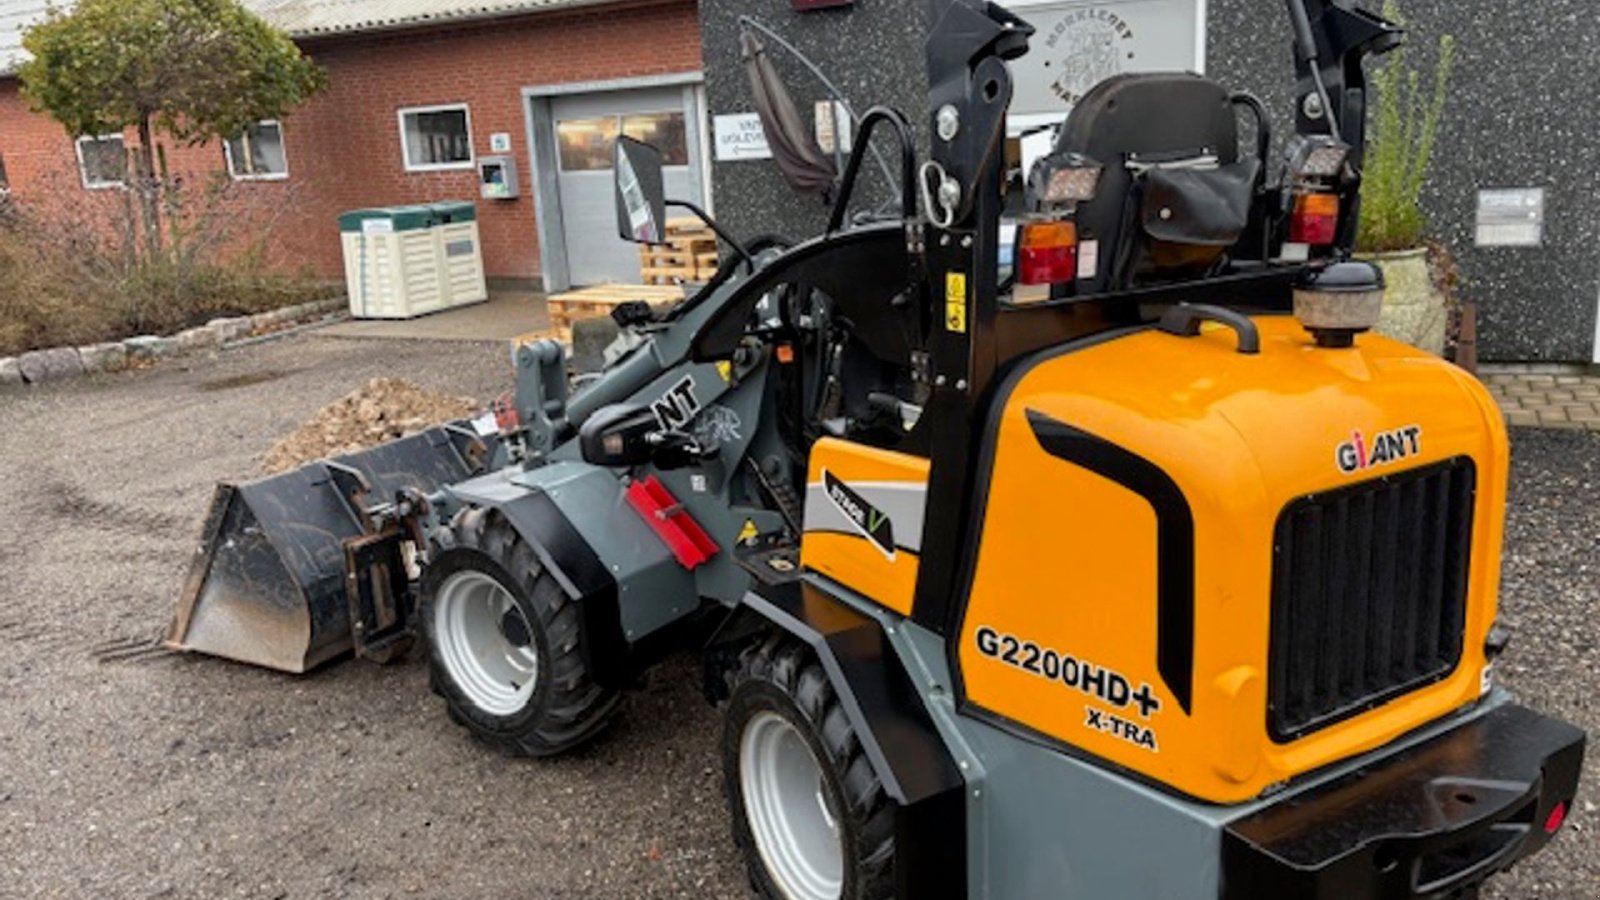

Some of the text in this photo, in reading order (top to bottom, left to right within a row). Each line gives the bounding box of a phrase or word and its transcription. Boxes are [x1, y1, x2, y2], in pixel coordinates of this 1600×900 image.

[868, 508, 888, 533] V
[976, 627, 1160, 717] G2200HD+
[1086, 708, 1157, 751] X-TRA
